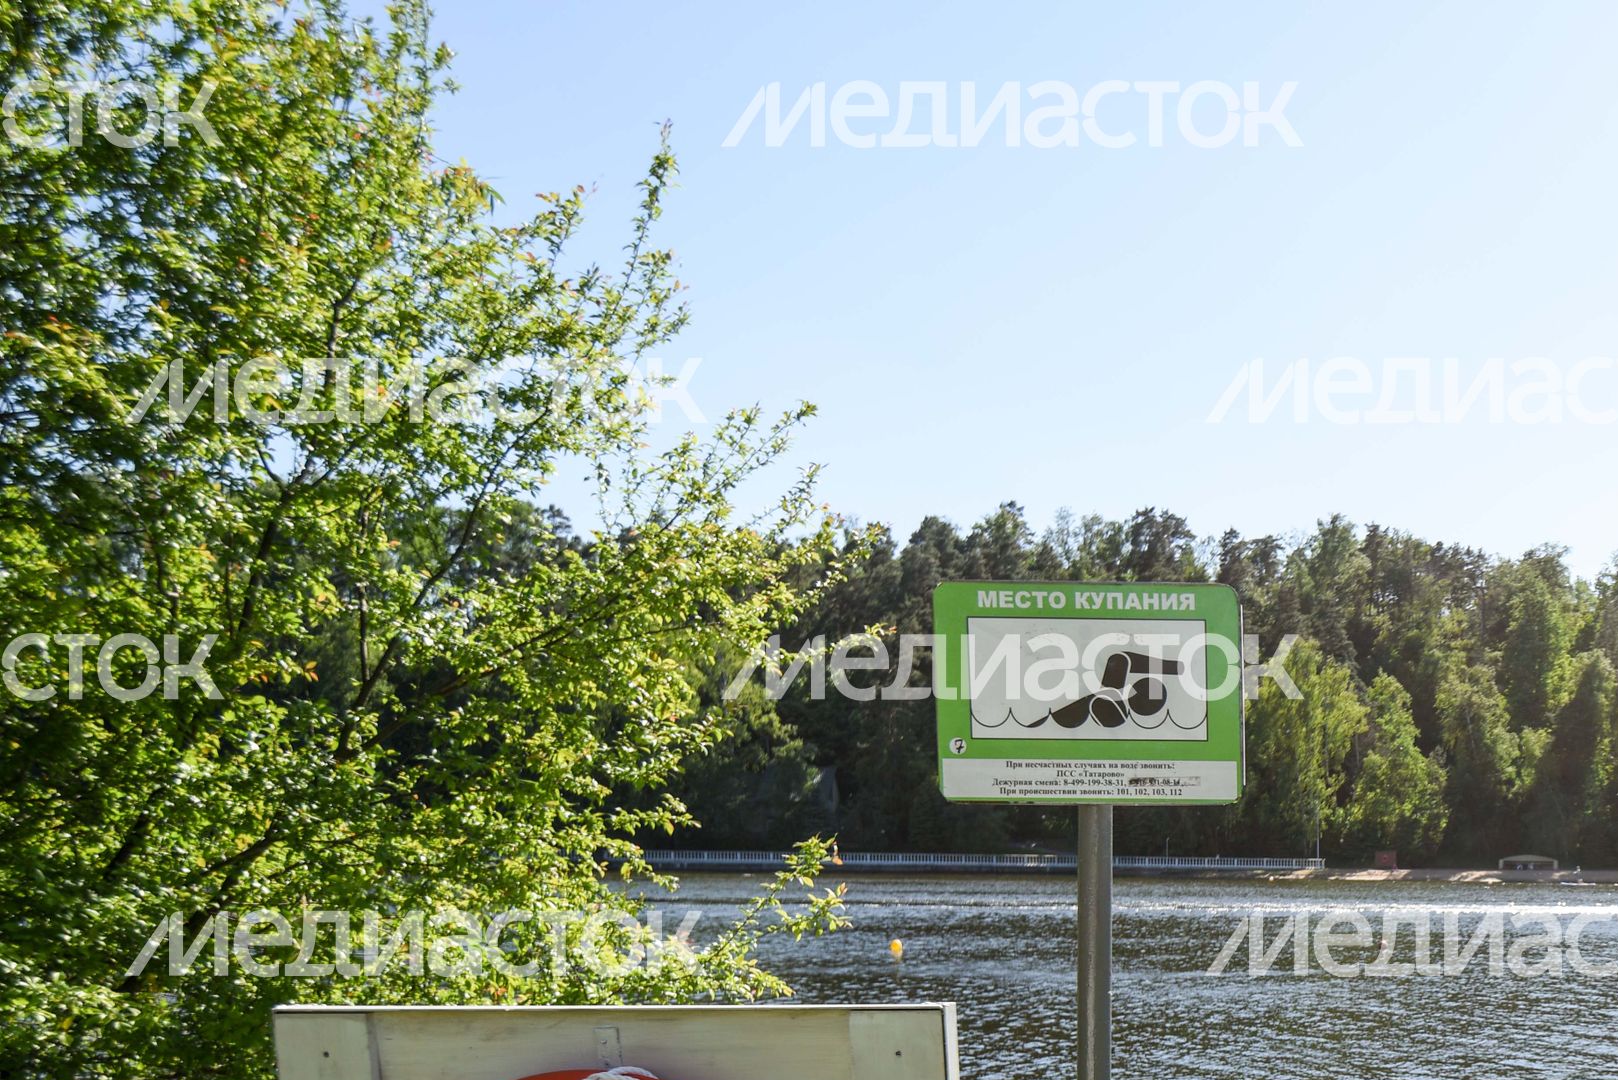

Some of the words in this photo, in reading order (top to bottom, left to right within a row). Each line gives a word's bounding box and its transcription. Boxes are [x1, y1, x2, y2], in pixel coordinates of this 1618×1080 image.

[977, 590, 1066, 609] МЕСТО
[1075, 591, 1196, 611] КУПАНИЯ
[954, 739, 965, 754] 7
[1006, 760, 1023, 769] При
[1074, 762, 1107, 770] случаях
[992, 778, 1033, 787] Дежурная
[1000, 787, 1017, 796] При
[1018, 788, 1077, 797] происшествии
[1079, 788, 1115, 796] звонить:
[1116, 788, 1132, 797] 101,
[1134, 788, 1150, 797] 102,
